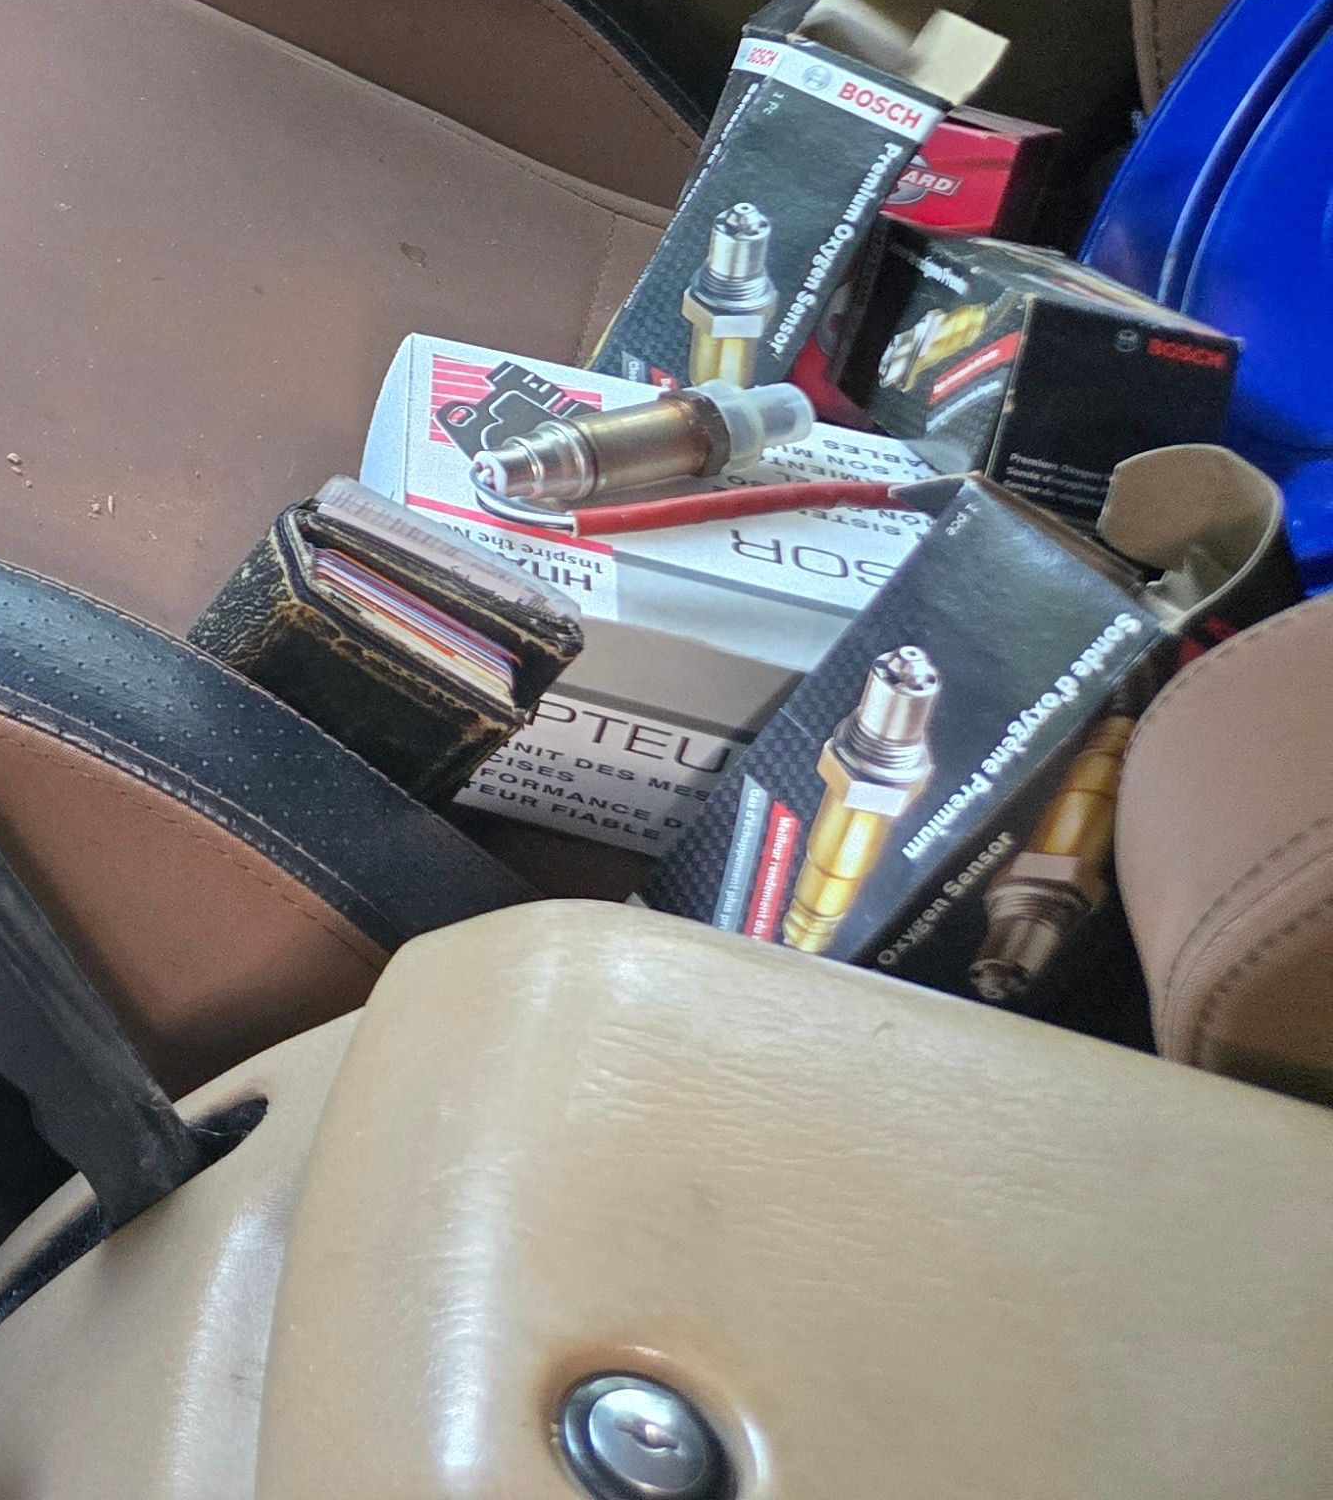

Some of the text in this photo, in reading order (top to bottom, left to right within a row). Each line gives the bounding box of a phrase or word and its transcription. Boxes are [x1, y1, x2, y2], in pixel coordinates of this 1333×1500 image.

[838, 81, 923, 130] BOSCH
[900, 170, 954, 192] ARD
[769, 141, 904, 356] Premium Oxygen Sensor
[822, 439, 928, 469] ABLES
[478, 530, 515, 551] the
[521, 542, 604, 575] Inspire
[729, 528, 899, 589] SOR
[527, 698, 732, 775] PTEU
[901, 611, 1142, 862] Sonde d'oxygène Premium
[487, 752, 575, 783] CISES
[509, 740, 712, 803] NIT DES MES
[479, 767, 654, 822] FORMANCE
[550, 802, 662, 842] FIABLE
[771, 815, 794, 861] Meilleur
[756, 861, 780, 918] rendement
[877, 830, 1017, 968] Oxygen Sensor
